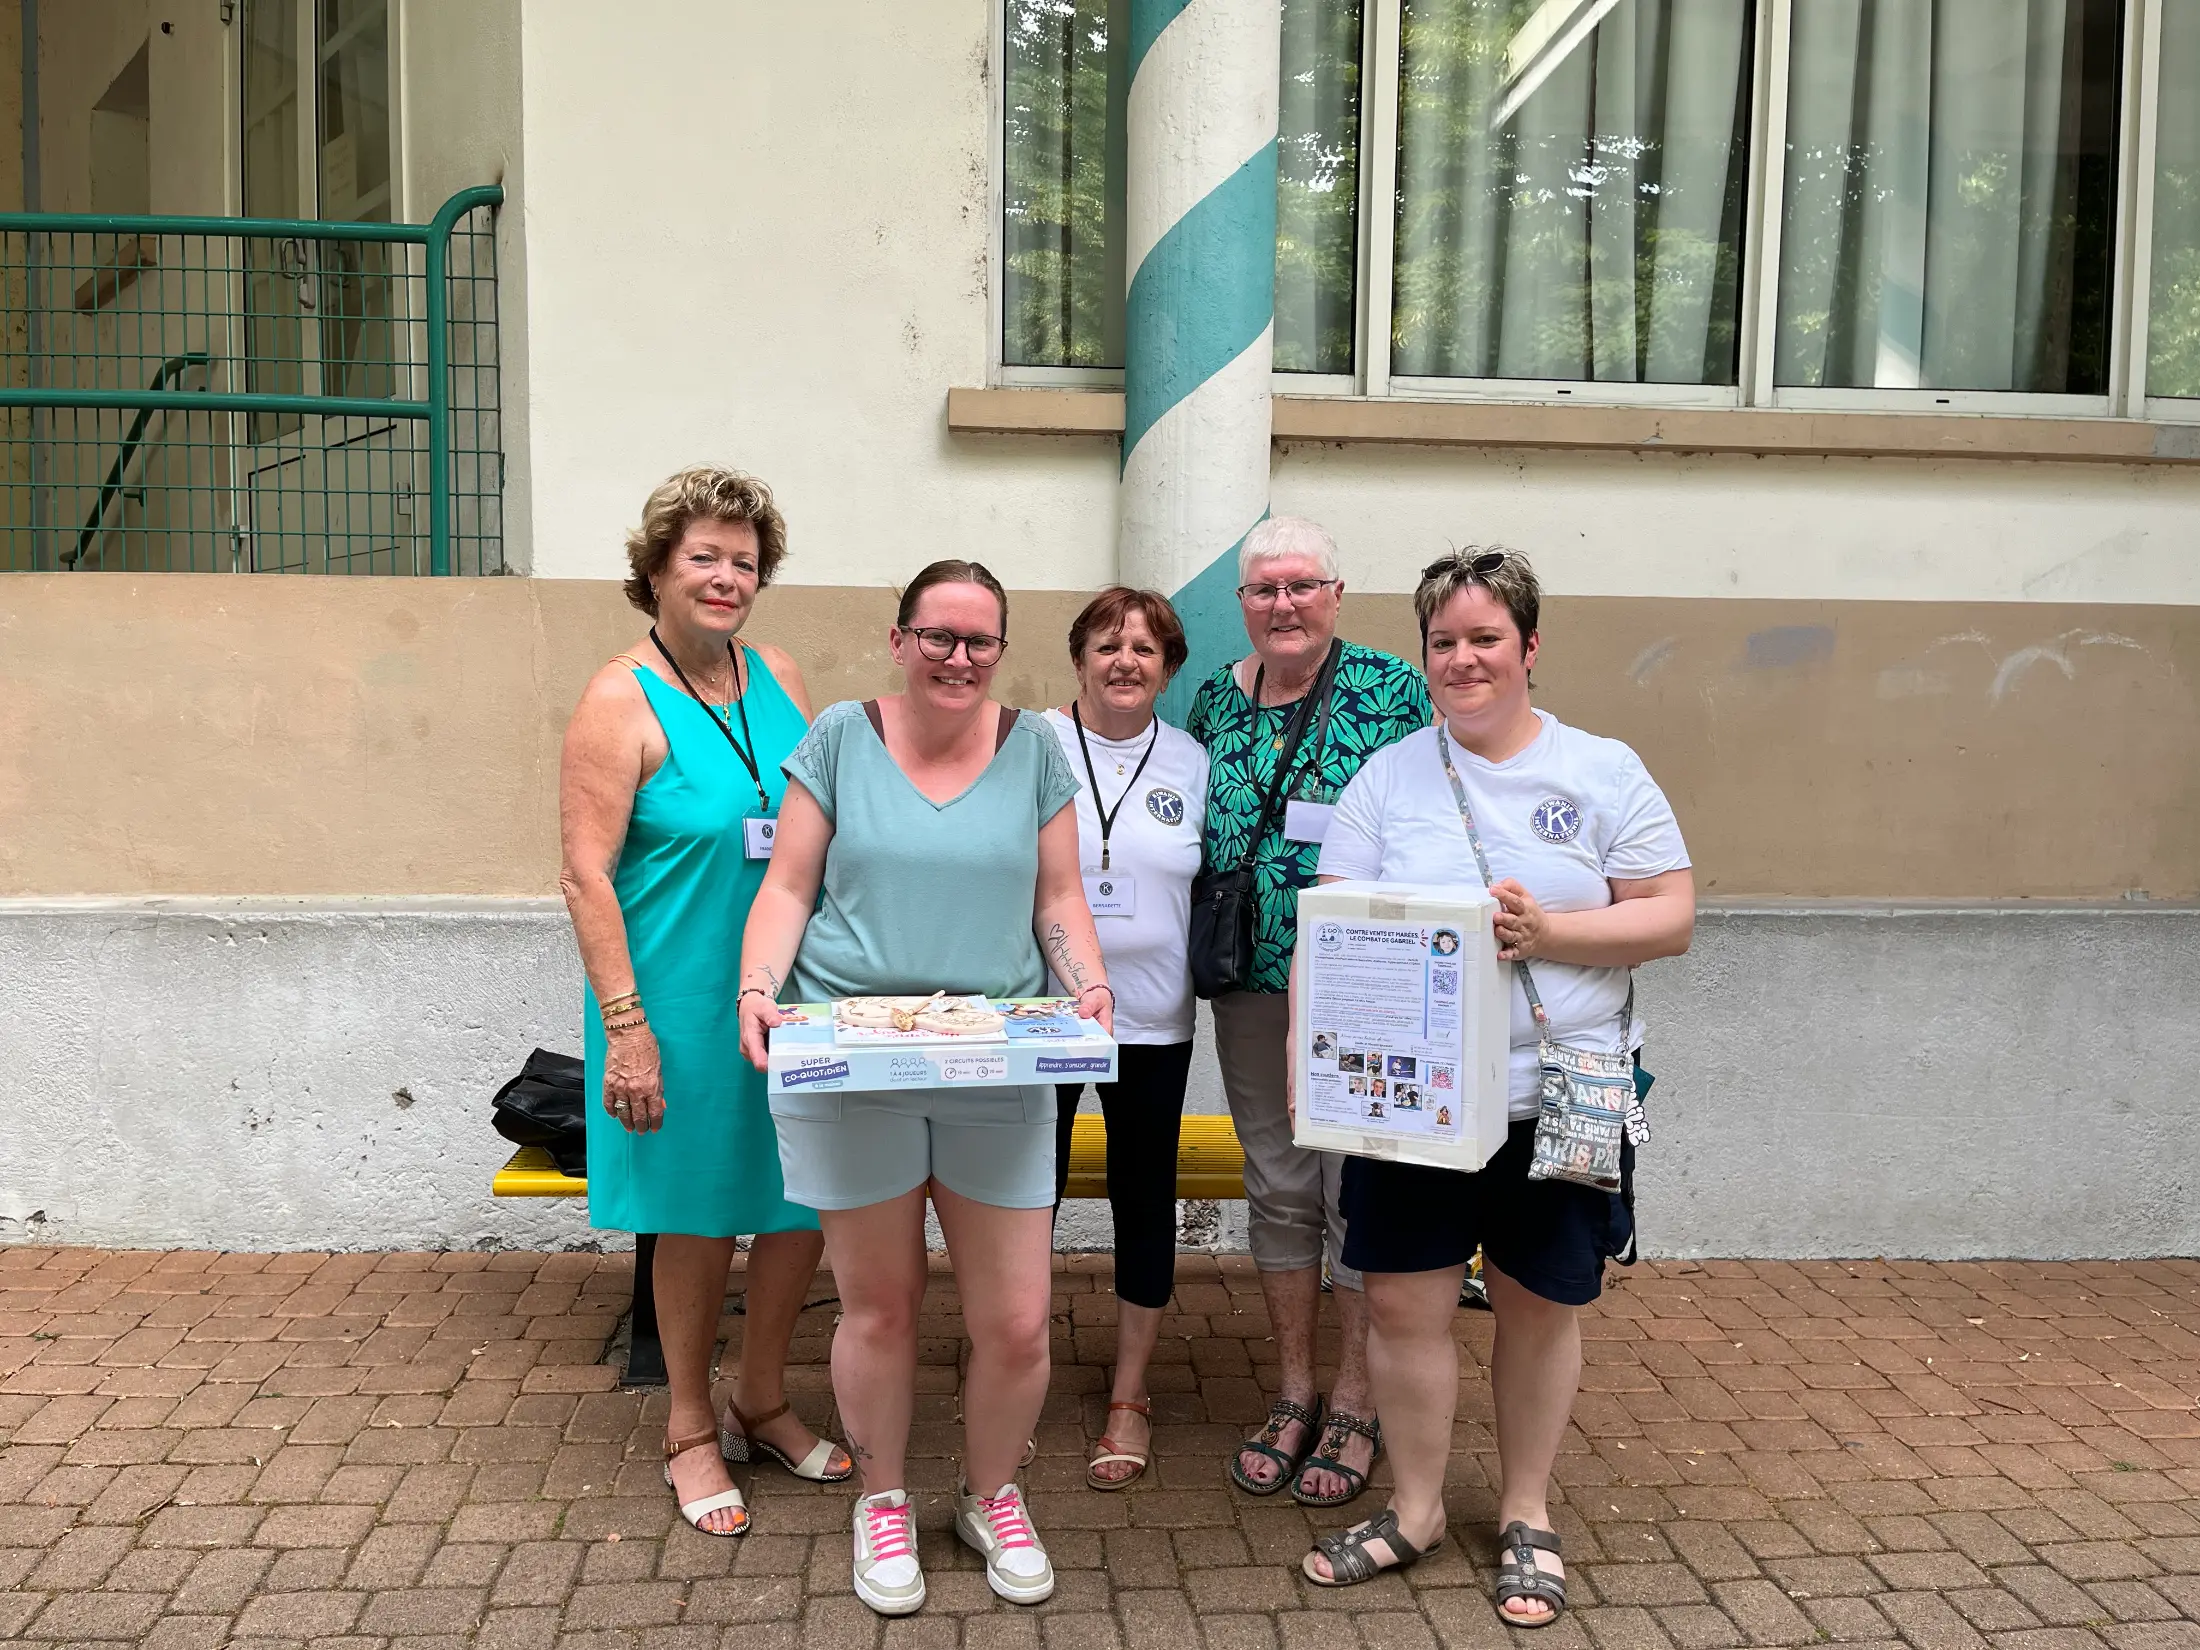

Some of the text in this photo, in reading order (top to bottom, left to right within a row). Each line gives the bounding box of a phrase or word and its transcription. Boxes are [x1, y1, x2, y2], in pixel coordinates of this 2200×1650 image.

[1540, 799, 1575, 812] KIWANIS
[1546, 806, 1569, 832] K
[1345, 928, 1369, 936] CONTRE
[1357, 935, 1382, 943] COMBAT
[800, 1057, 831, 1068] SUPER
